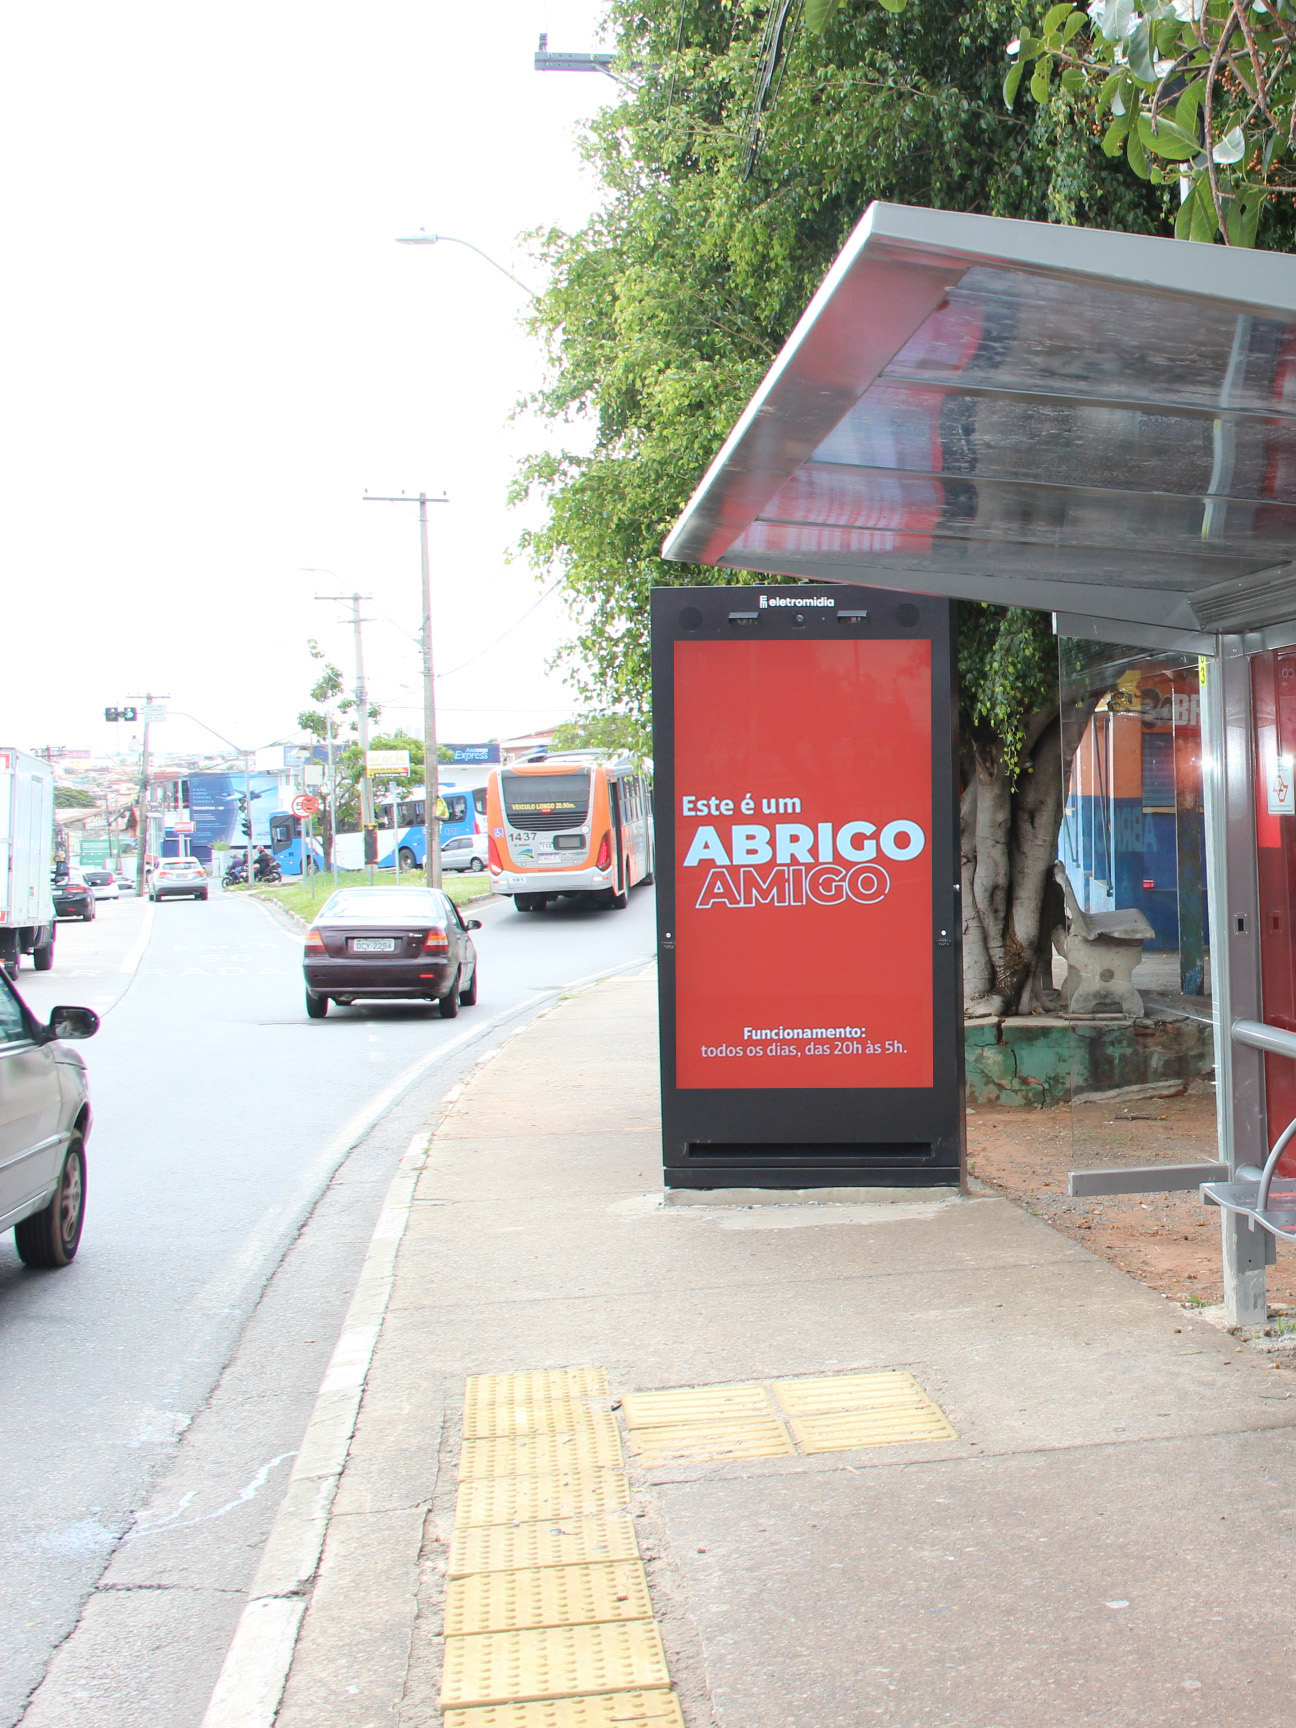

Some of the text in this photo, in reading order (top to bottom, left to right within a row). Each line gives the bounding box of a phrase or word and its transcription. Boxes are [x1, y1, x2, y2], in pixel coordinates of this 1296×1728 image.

[769, 597, 835, 607] eletromidia
[454, 750, 489, 762] Express
[536, 802, 555, 810] LONGO
[682, 793, 801, 817] Este é um
[508, 832, 538, 842] 1437
[682, 819, 926, 867] ABRIGO
[695, 862, 890, 909] AMIGO
[743, 1025, 867, 1041] Funcionamento:
[700, 1039, 908, 1058] todos os dias, das 20h às 5h.
